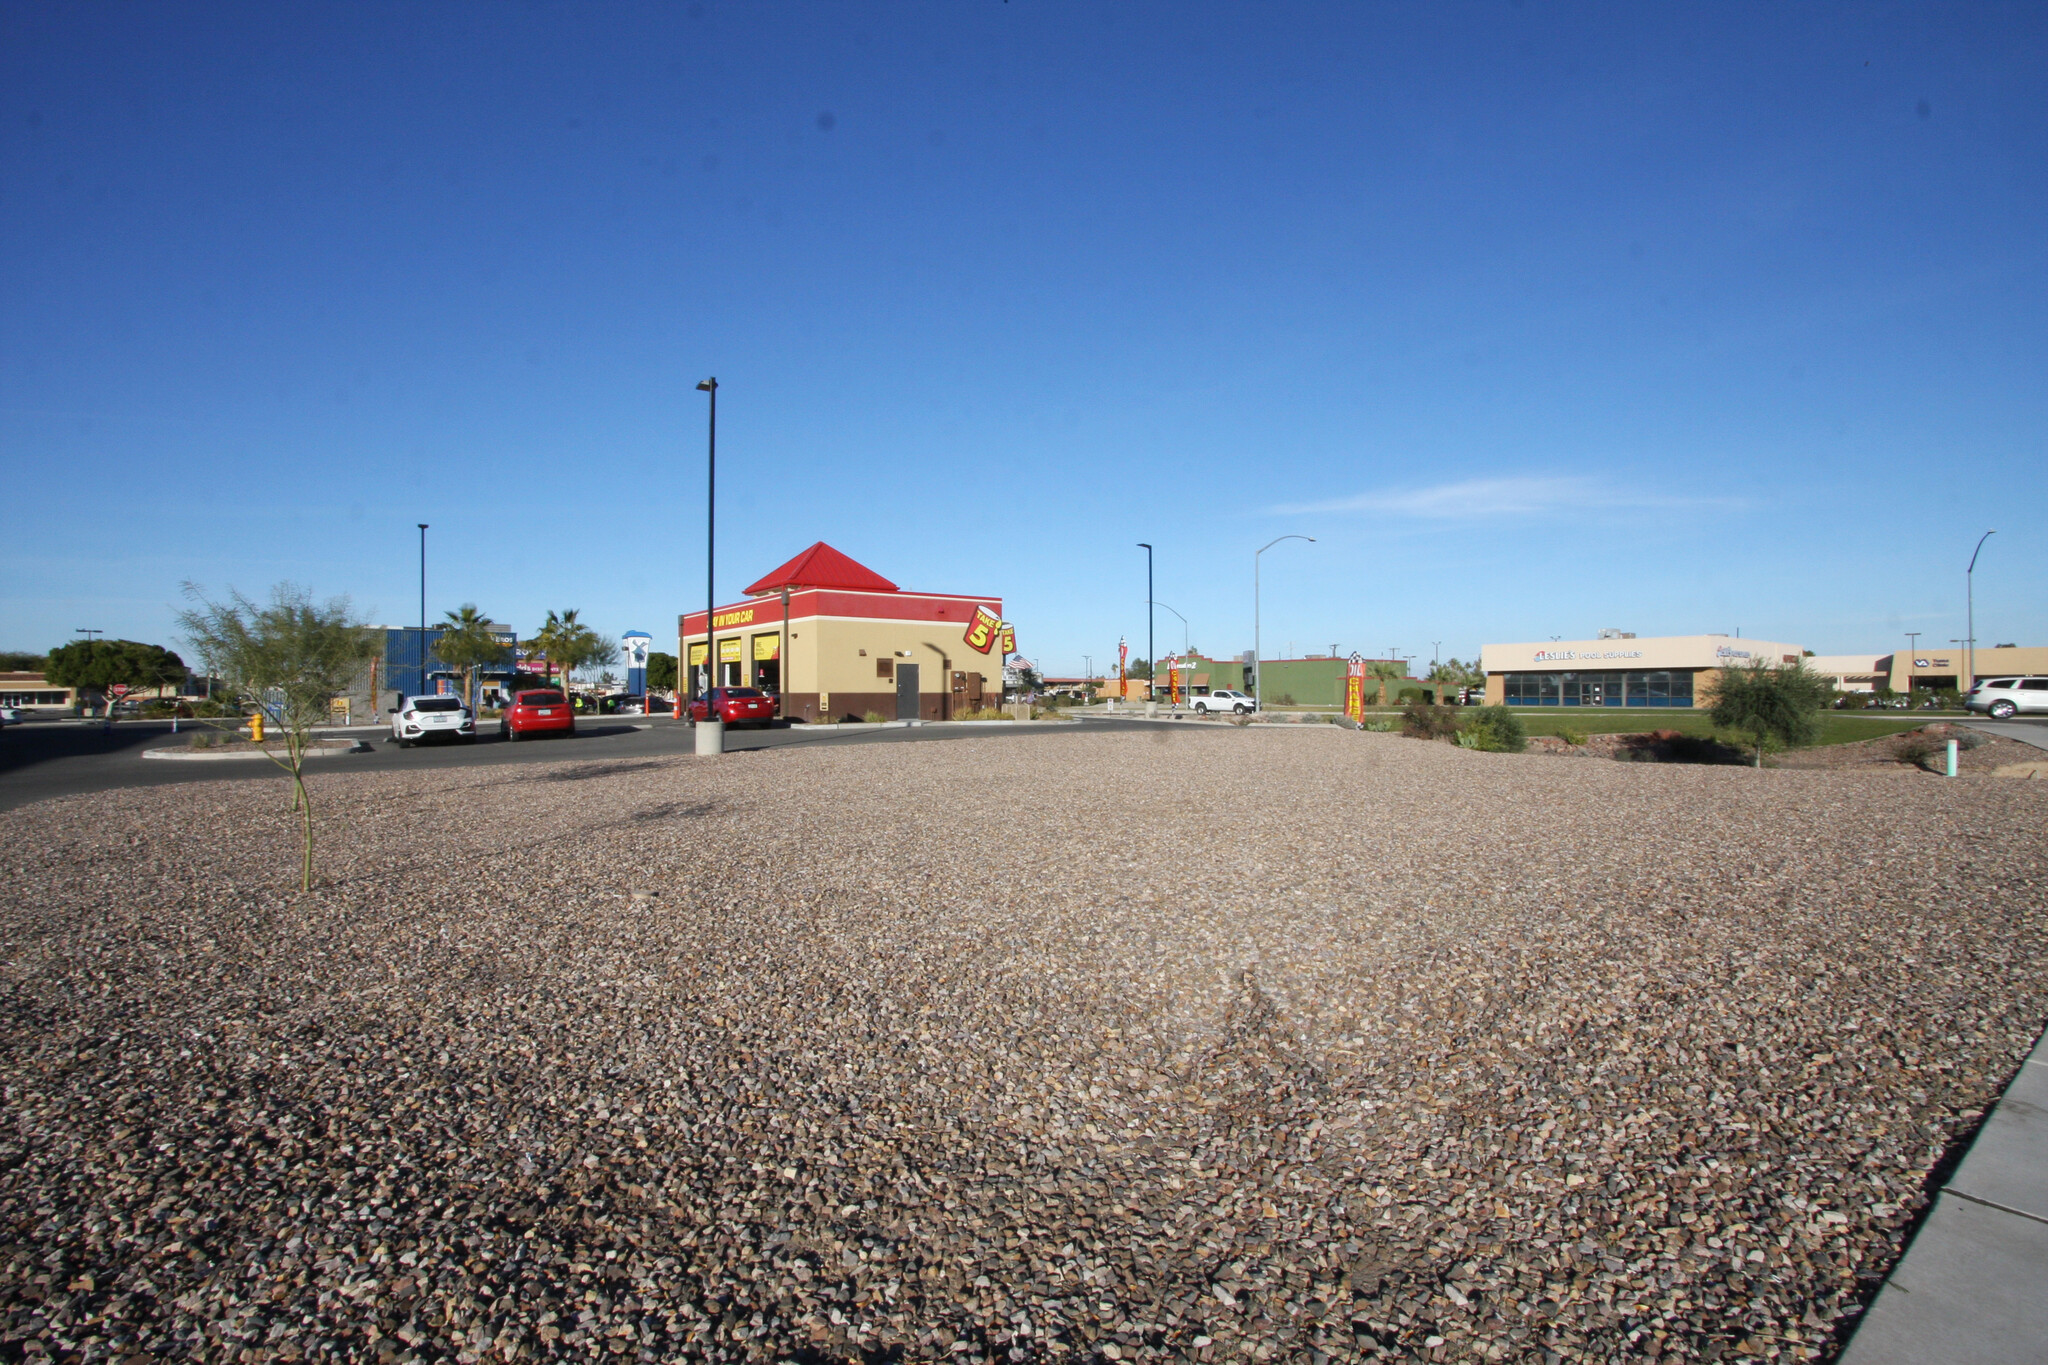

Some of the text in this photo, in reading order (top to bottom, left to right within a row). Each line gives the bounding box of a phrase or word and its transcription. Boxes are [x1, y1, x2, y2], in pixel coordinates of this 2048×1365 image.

[719, 615, 726, 626] IN
[726, 612, 740, 625] YOUR
[740, 609, 754, 623] CAR
[976, 610, 996, 628] TAKE
[969, 624, 989, 647] 5
[1003, 636, 1014, 652] 5
[1539, 650, 1643, 660] LESLIE'S POOL SUPPLIES
